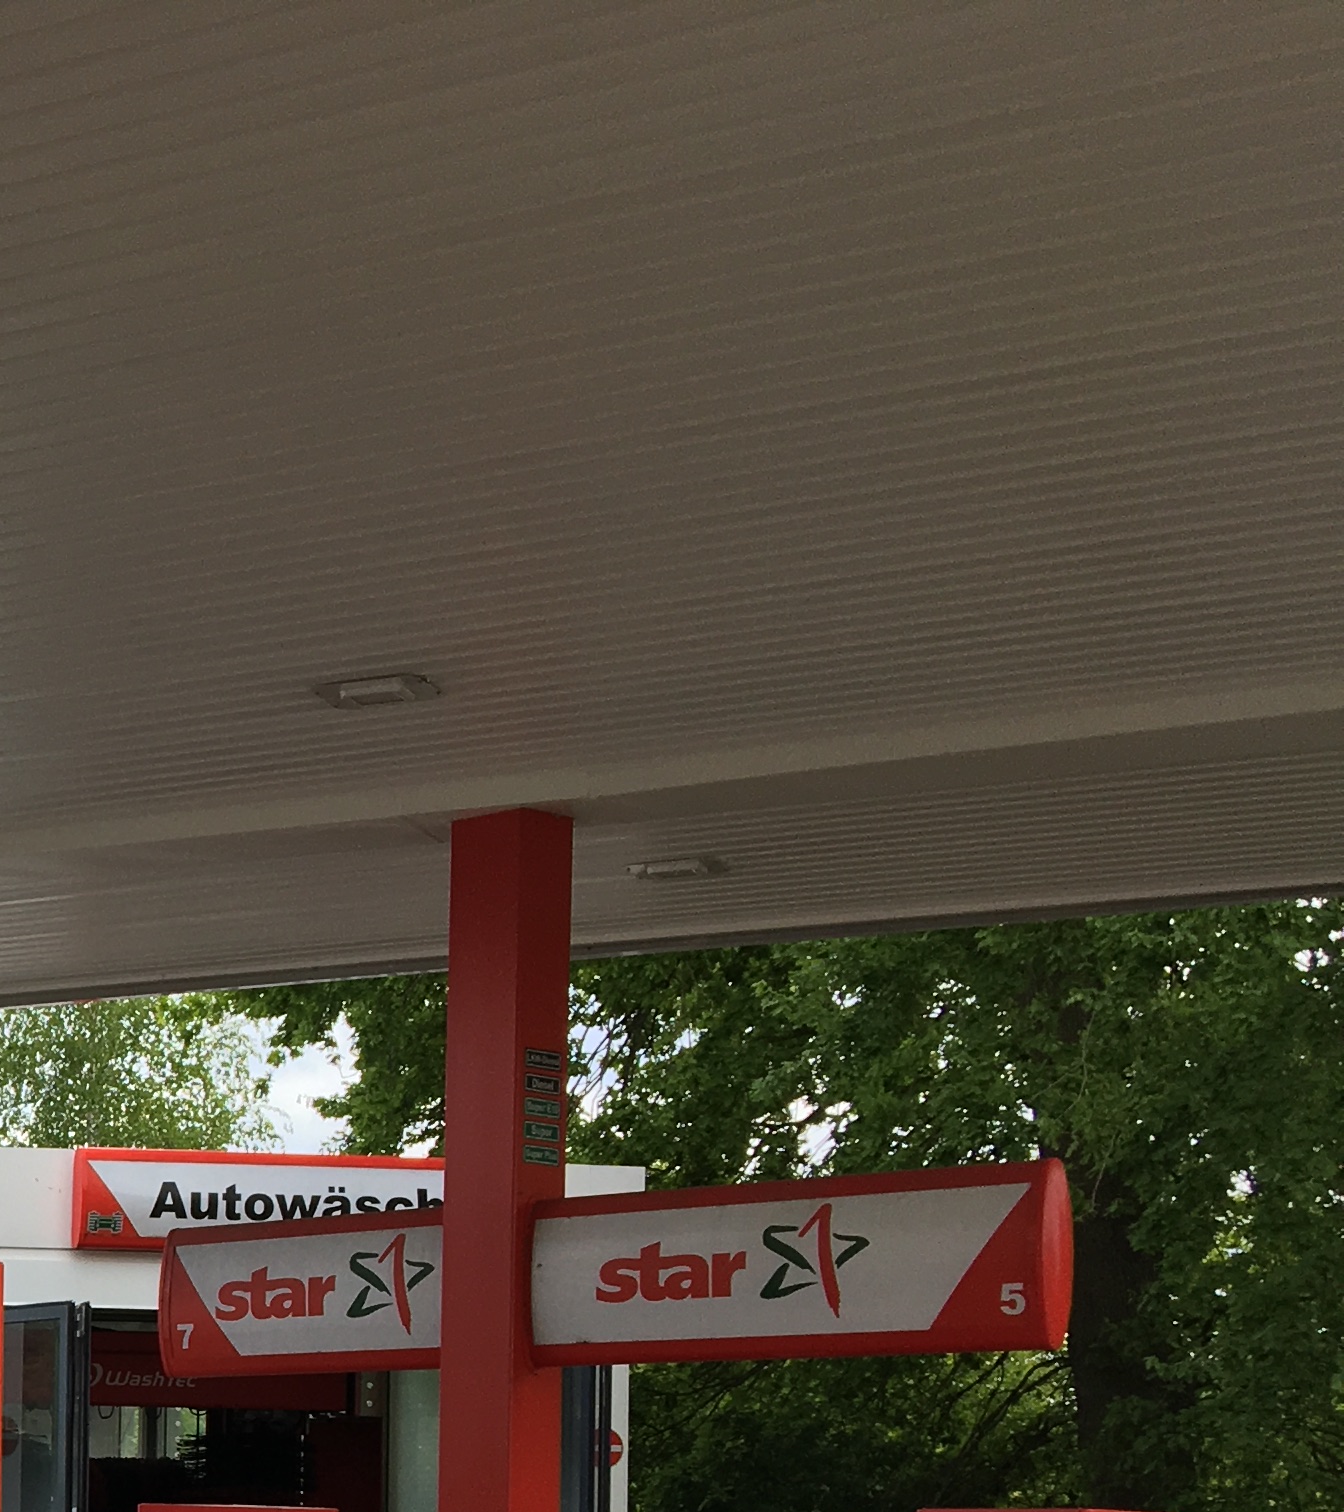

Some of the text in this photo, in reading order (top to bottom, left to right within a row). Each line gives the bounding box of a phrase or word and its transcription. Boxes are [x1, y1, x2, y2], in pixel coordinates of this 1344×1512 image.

[214, 1266, 336, 1321] star
[595, 1241, 747, 1304] star
[1000, 1282, 1026, 1316] 5
[176, 1323, 193, 1350] 7
